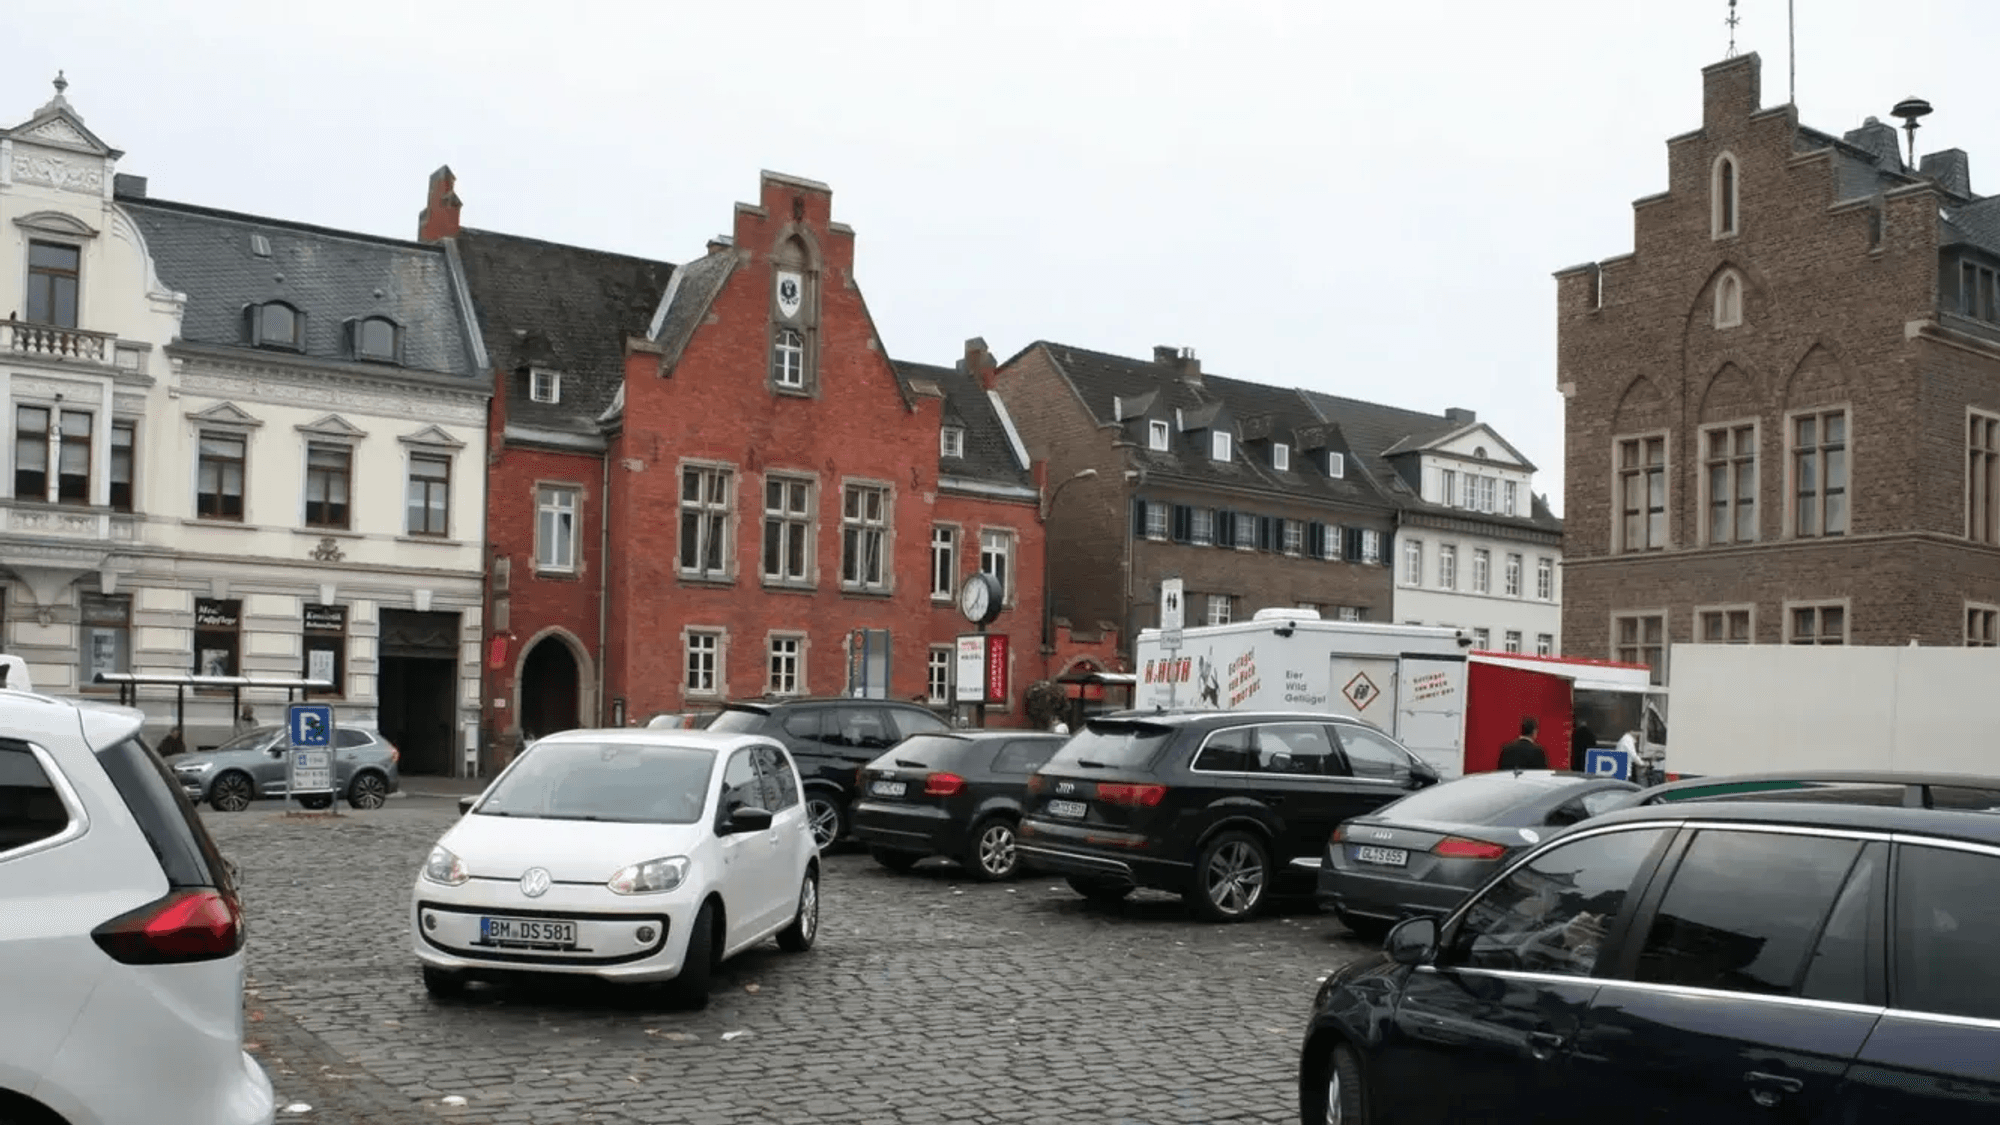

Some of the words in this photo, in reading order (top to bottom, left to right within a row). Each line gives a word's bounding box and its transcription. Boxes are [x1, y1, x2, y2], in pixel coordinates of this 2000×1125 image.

[1285, 670, 1303, 679] Eier
[1286, 682, 1307, 691] Wild
[1285, 694, 1326, 705] Geflügel
[299, 712, 321, 742] P
[490, 921, 511, 937] BM
[521, 923, 540, 939] DS
[543, 924, 572, 941] 581
